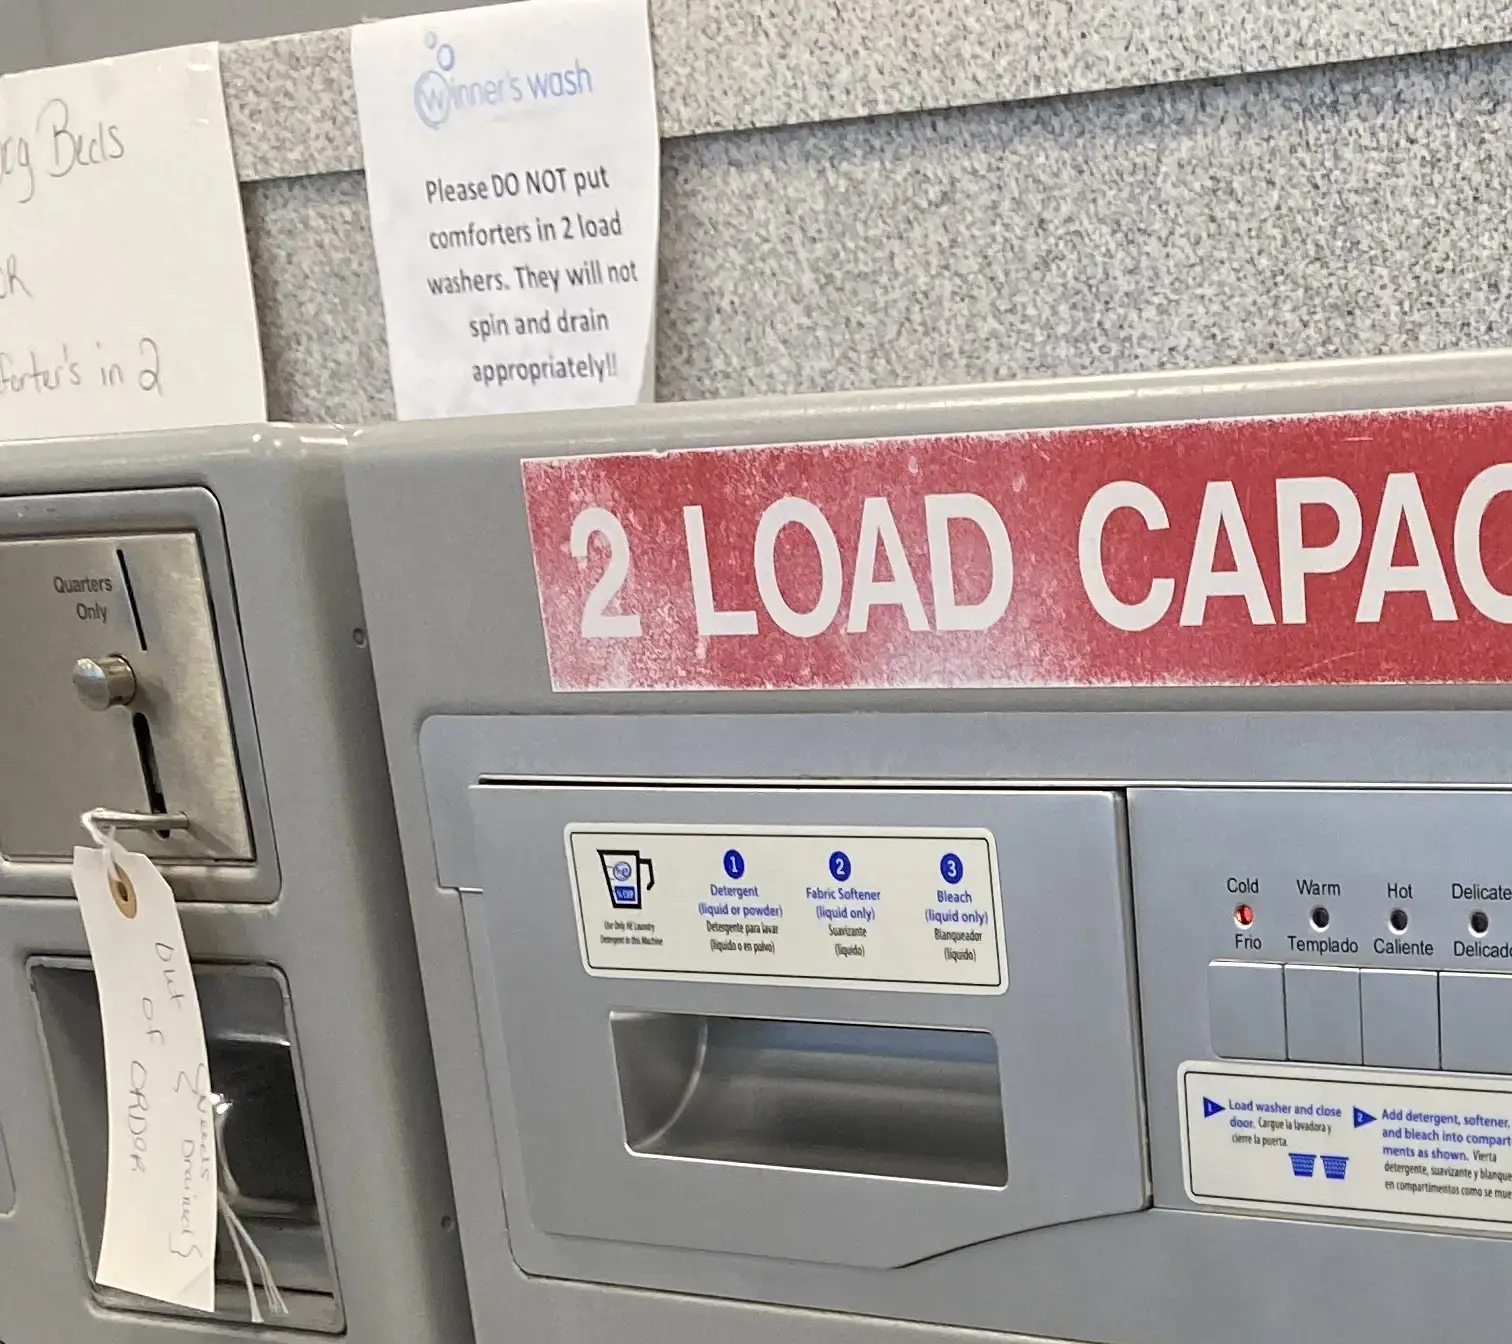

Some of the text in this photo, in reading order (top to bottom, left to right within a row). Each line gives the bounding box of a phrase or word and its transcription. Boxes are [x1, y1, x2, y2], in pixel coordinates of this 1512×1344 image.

[527, 57, 593, 100] wash
[425, 165, 610, 204] Please DO NOT put
[429, 209, 622, 250] comforters in 2 load
[427, 260, 638, 295] washers. They will not
[469, 307, 609, 342] spin and drain
[137, 337, 162, 397] 2
[472, 352, 618, 386] appropriately!!
[570, 509, 642, 639] 2
[685, 492, 1013, 636] LOAD
[53, 575, 113, 595] Quarters
[76, 603, 108, 623] Only
[710, 884, 759, 899] Detergent
[806, 886, 881, 901] Fabric Softener
[1226, 877, 1259, 894] Cold
[1296, 879, 1341, 897] Warm
[1387, 883, 1413, 899] Hot
[1452, 884, 1512, 901] Delicate
[937, 889, 972, 903] Bleach
[699, 903, 783, 917] (liquid or powder)
[816, 905, 875, 921] (liquid only)
[925, 908, 988, 926] (liquid only)
[706, 920, 744, 935] Detergente
[745, 923, 761, 936] para
[828, 924, 867, 937] Suavizante
[934, 927, 982, 943] Blanqueador
[1235, 934, 1262, 950] Frio
[1287, 936, 1359, 955] Templado
[1373, 938, 1434, 956] Caliente
[1228, 1098, 1342, 1117] Load washer and close
[1230, 1116, 1332, 1135] door. Cargue la lavadora y
[1382, 1108, 1511, 1129] Add detergent, softener,
[1231, 1133, 1289, 1147] cierre la puerta.
[1382, 1127, 1402, 1139] and
[1404, 1128, 1440, 1142] bleach
[1442, 1132, 1464, 1143] into
[1382, 1146, 1497, 1163] ments as shown. Vierta
[1384, 1162, 1429, 1177] detergente,
[1431, 1166, 1472, 1179] suavizante
[1473, 1170, 1479, 1181] y
[1385, 1180, 1395, 1190] en
[1396, 1182, 1460, 1195] compartimentos
[1461, 1187, 1483, 1198] como
[1484, 1189, 1492, 1198] se
